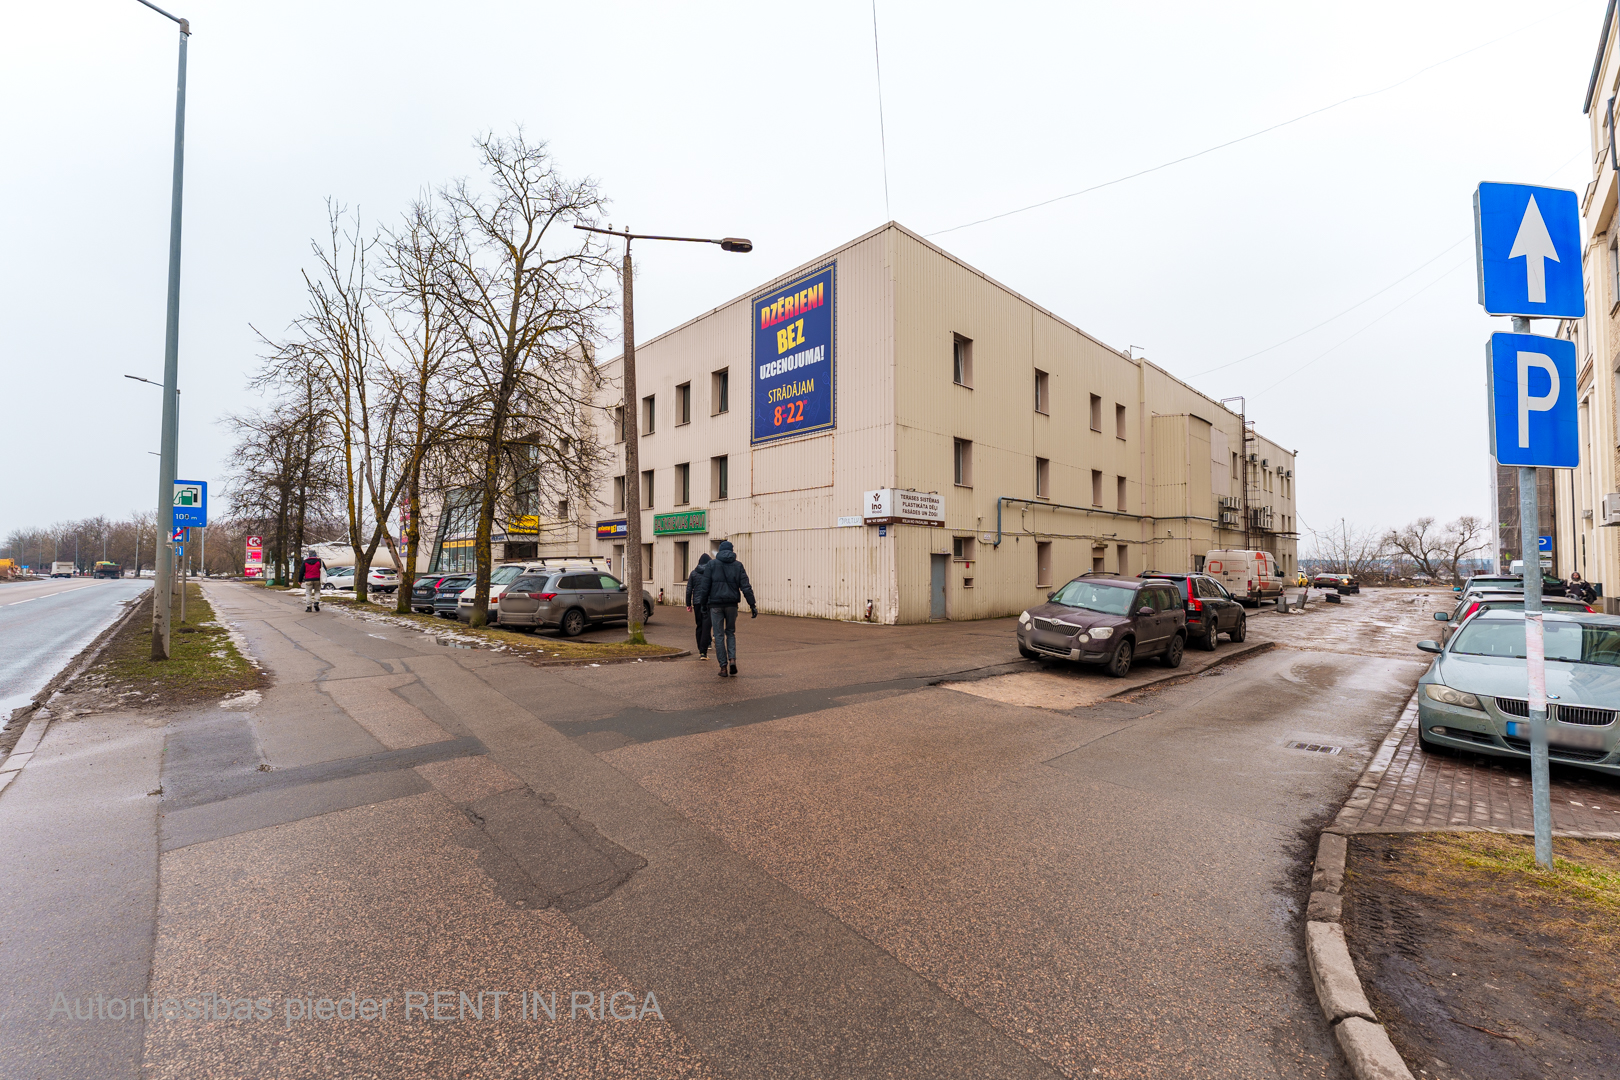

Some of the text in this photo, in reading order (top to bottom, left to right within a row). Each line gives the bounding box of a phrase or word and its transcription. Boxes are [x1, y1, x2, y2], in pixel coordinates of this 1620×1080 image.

[761, 282, 824, 330] DZĒRIENI
[777, 318, 805, 354] BEZ
[760, 345, 825, 380] UZCENOJUMA!
[768, 378, 814, 404] STRĀDĀJAM
[1517, 351, 1560, 449] P
[902, 508, 921, 516] FASĀDES
[920, 496, 940, 504] SISTĒMAS
